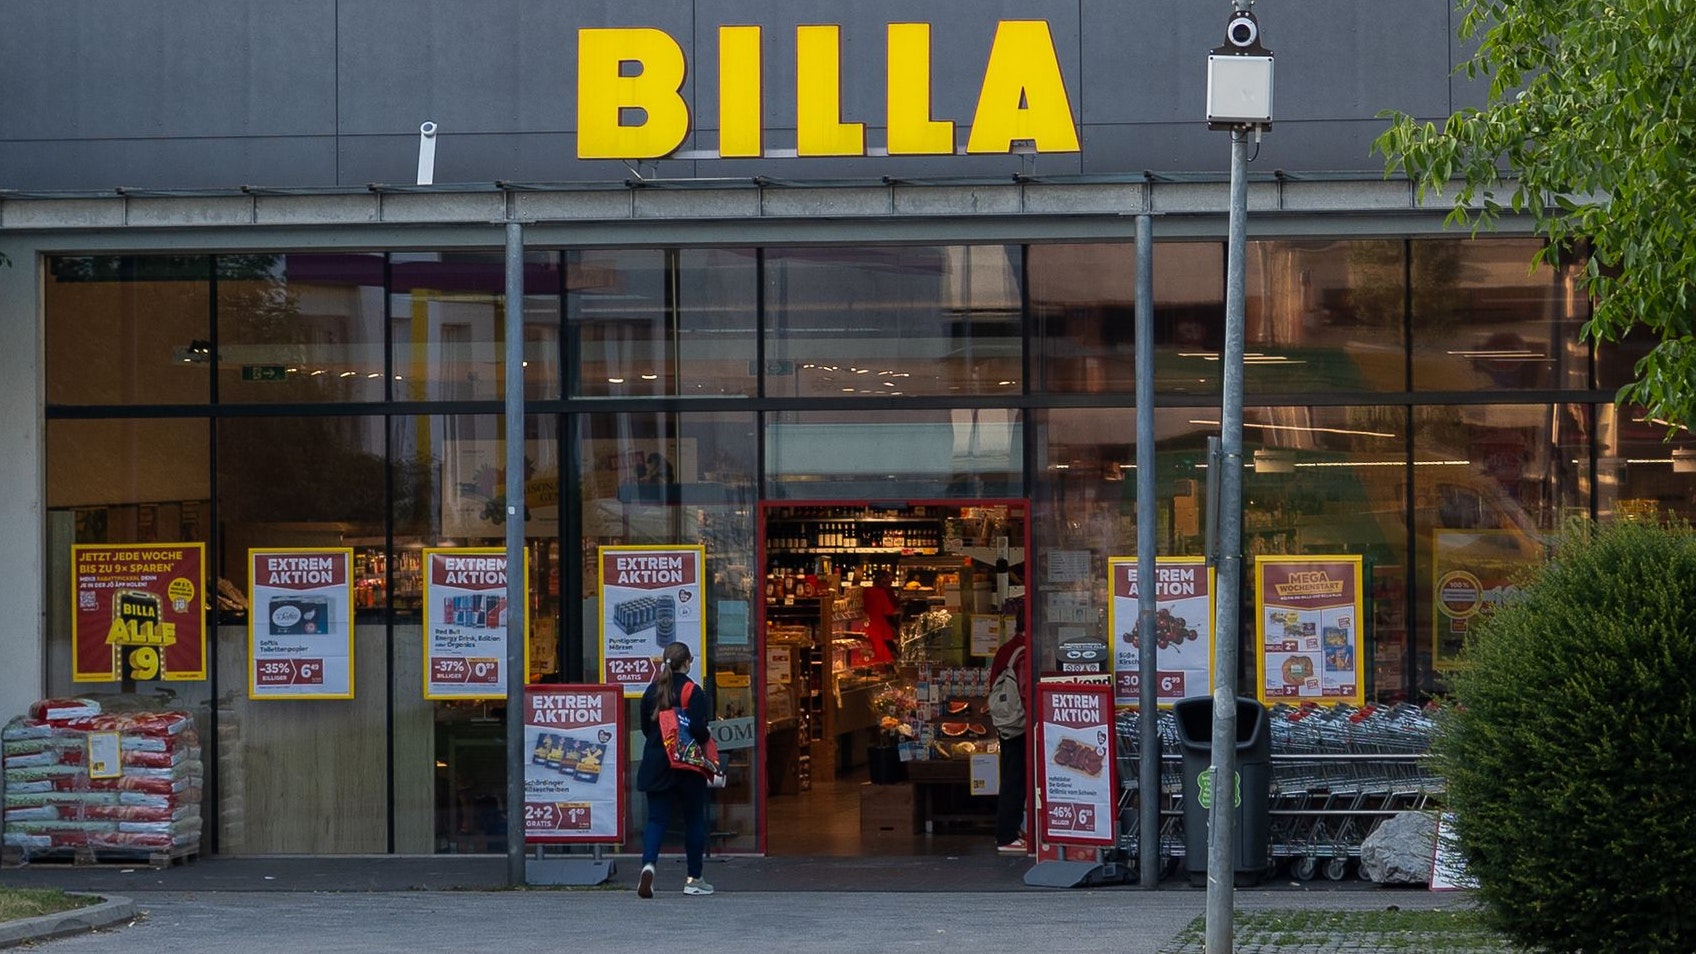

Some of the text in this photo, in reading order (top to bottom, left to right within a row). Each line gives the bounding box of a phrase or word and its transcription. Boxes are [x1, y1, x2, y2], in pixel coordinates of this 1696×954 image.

[577, 19, 1082, 160] BILLA
[80, 551, 182, 561] JETZT JEDE WOCHE
[80, 564, 96, 573] BIS
[99, 564, 112, 573] ZU
[268, 557, 332, 571] EXTREM
[445, 557, 507, 571] EXTREM
[617, 557, 683, 570] EXTREM
[269, 570, 332, 584] AKTION
[446, 571, 507, 584] AKTION
[618, 570, 683, 584] AKTION
[1128, 568, 1195, 582] EREM
[1289, 572, 1328, 584] MEGA
[1128, 581, 1195, 595] ATION
[1279, 582, 1340, 593] WOCHENSTART
[123, 603, 155, 617] BILLA
[106, 617, 176, 646] ALLE
[435, 635, 457, 643] Energy
[130, 647, 159, 680] 9
[260, 663, 290, 674] -35%
[435, 661, 464, 672] -37%
[609, 660, 649, 674] 12+12
[1118, 675, 1139, 686] -30
[532, 694, 602, 709] EXTREM
[1051, 694, 1099, 709] EXTREM
[533, 709, 602, 723] AKTION
[1053, 708, 1100, 723] AKTION
[525, 805, 553, 820] 2+2
[1049, 806, 1073, 818] -46%
